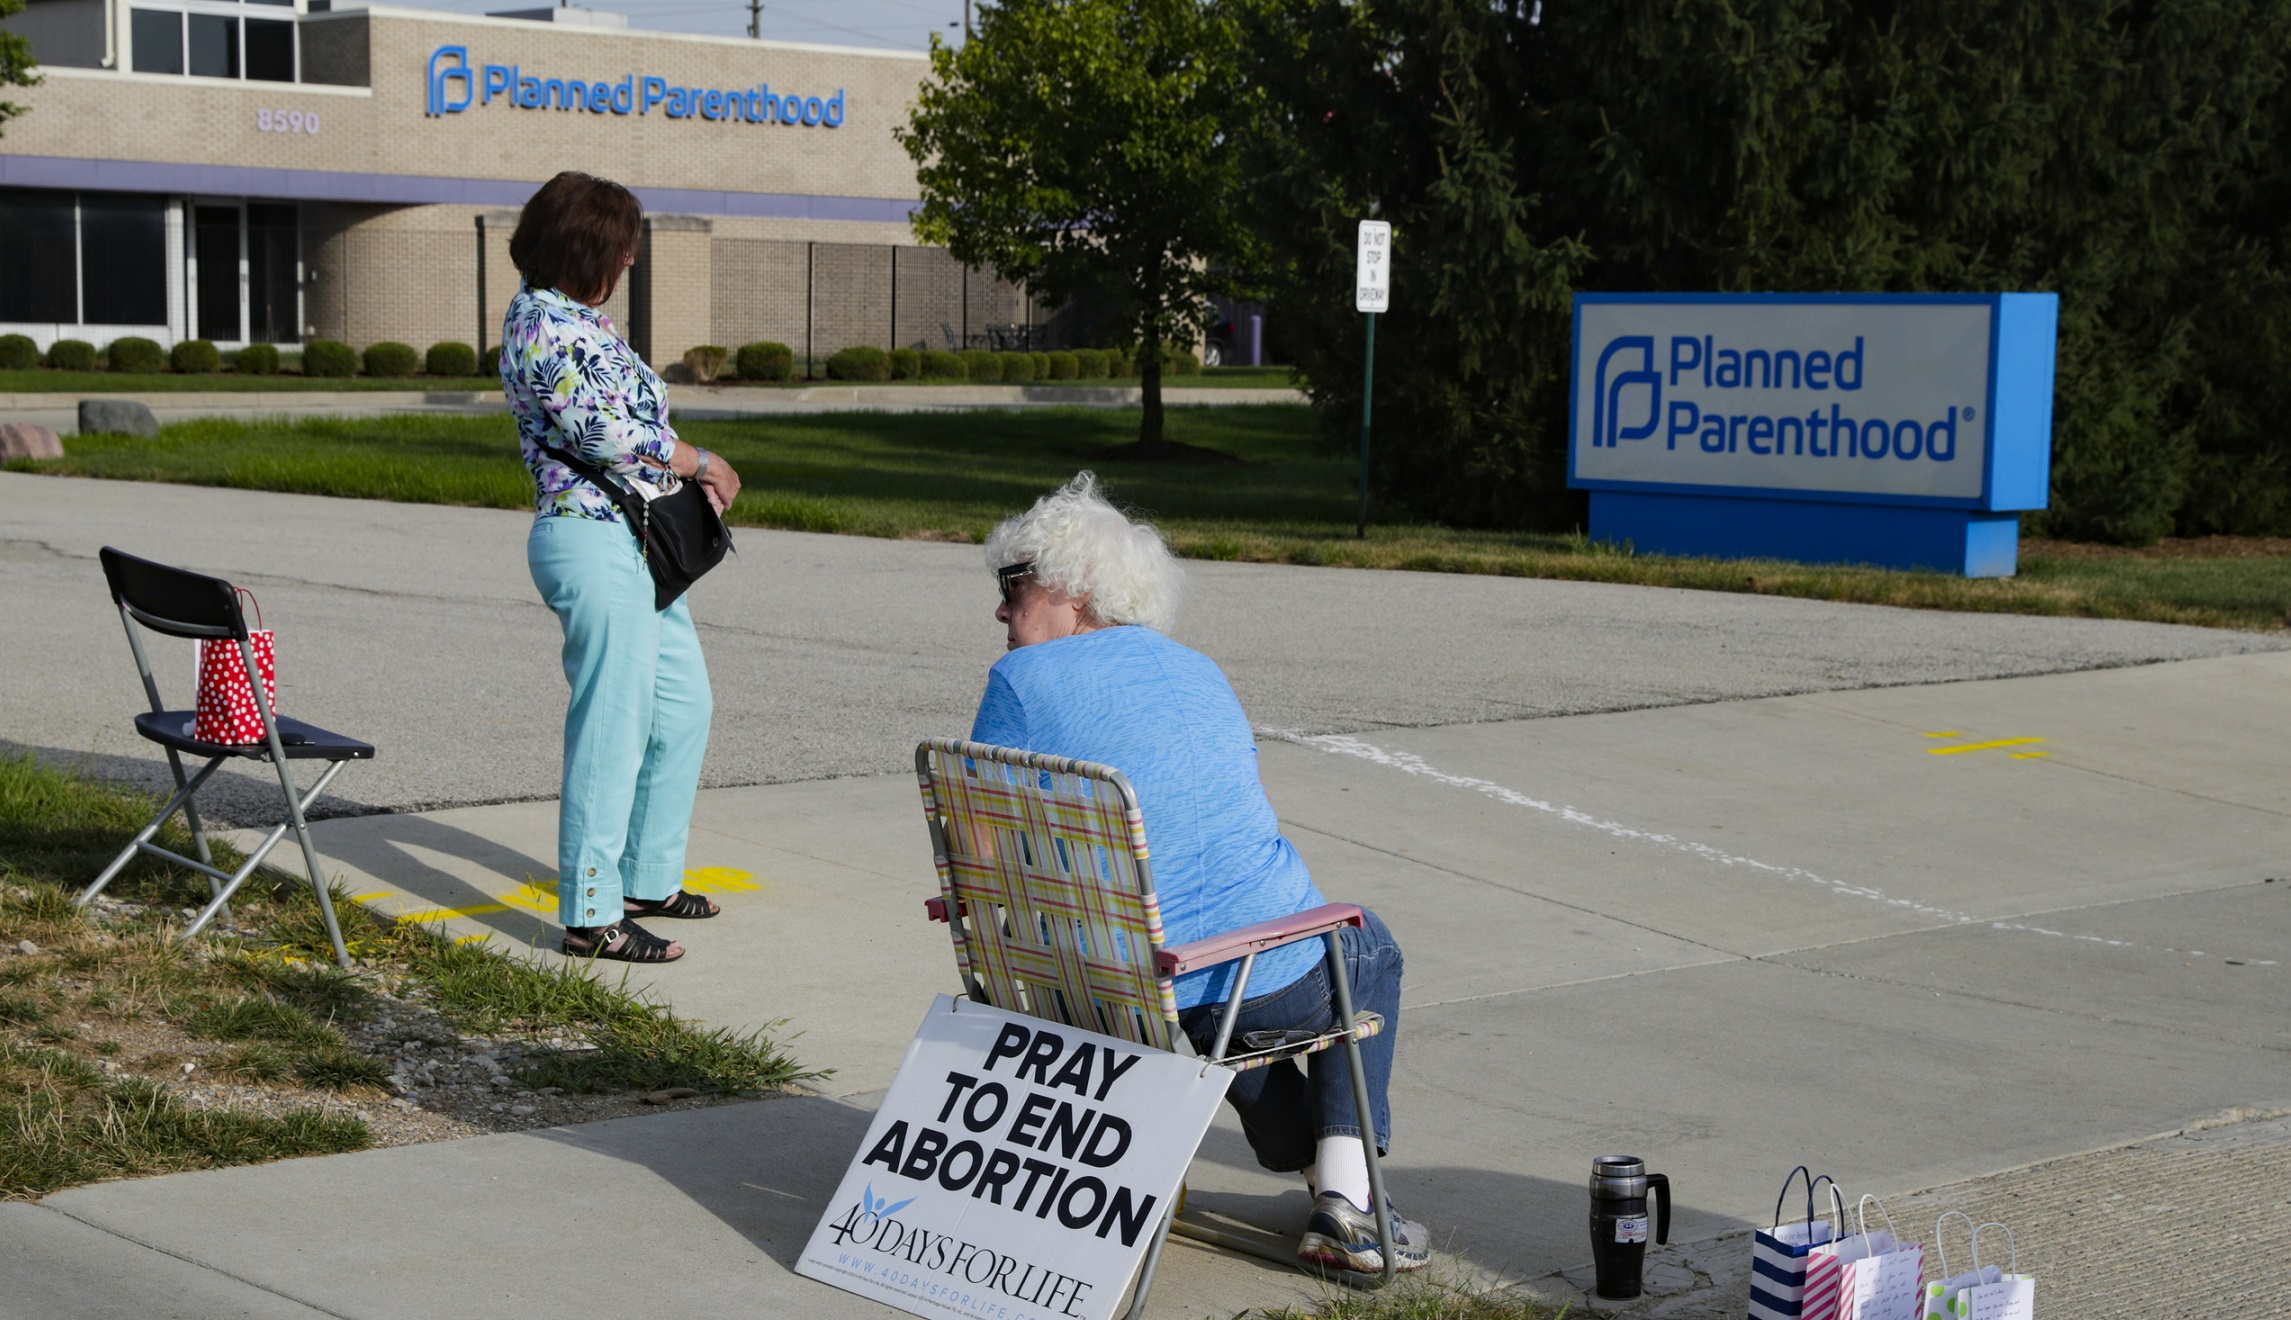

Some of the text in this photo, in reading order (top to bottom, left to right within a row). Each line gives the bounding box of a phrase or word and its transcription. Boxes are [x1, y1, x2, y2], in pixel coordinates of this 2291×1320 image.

[257, 108, 319, 134] 8590
[482, 64, 844, 128] Planned Parenthood
[1367, 250, 1382, 264] STOP
[1374, 232, 1386, 246] NOT
[1360, 287, 1386, 301] DRIVEWAY
[1370, 269, 1377, 283] IN
[1669, 335, 1864, 391] Planned
[983, 1022, 1142, 1102] PRAY
[937, 1071, 1132, 1168] TO END
[862, 1119, 1157, 1248] ABORTION
[829, 1202, 878, 1247] 40
[871, 1218, 953, 1270] DAYS
[945, 1241, 1017, 1295] FOR
